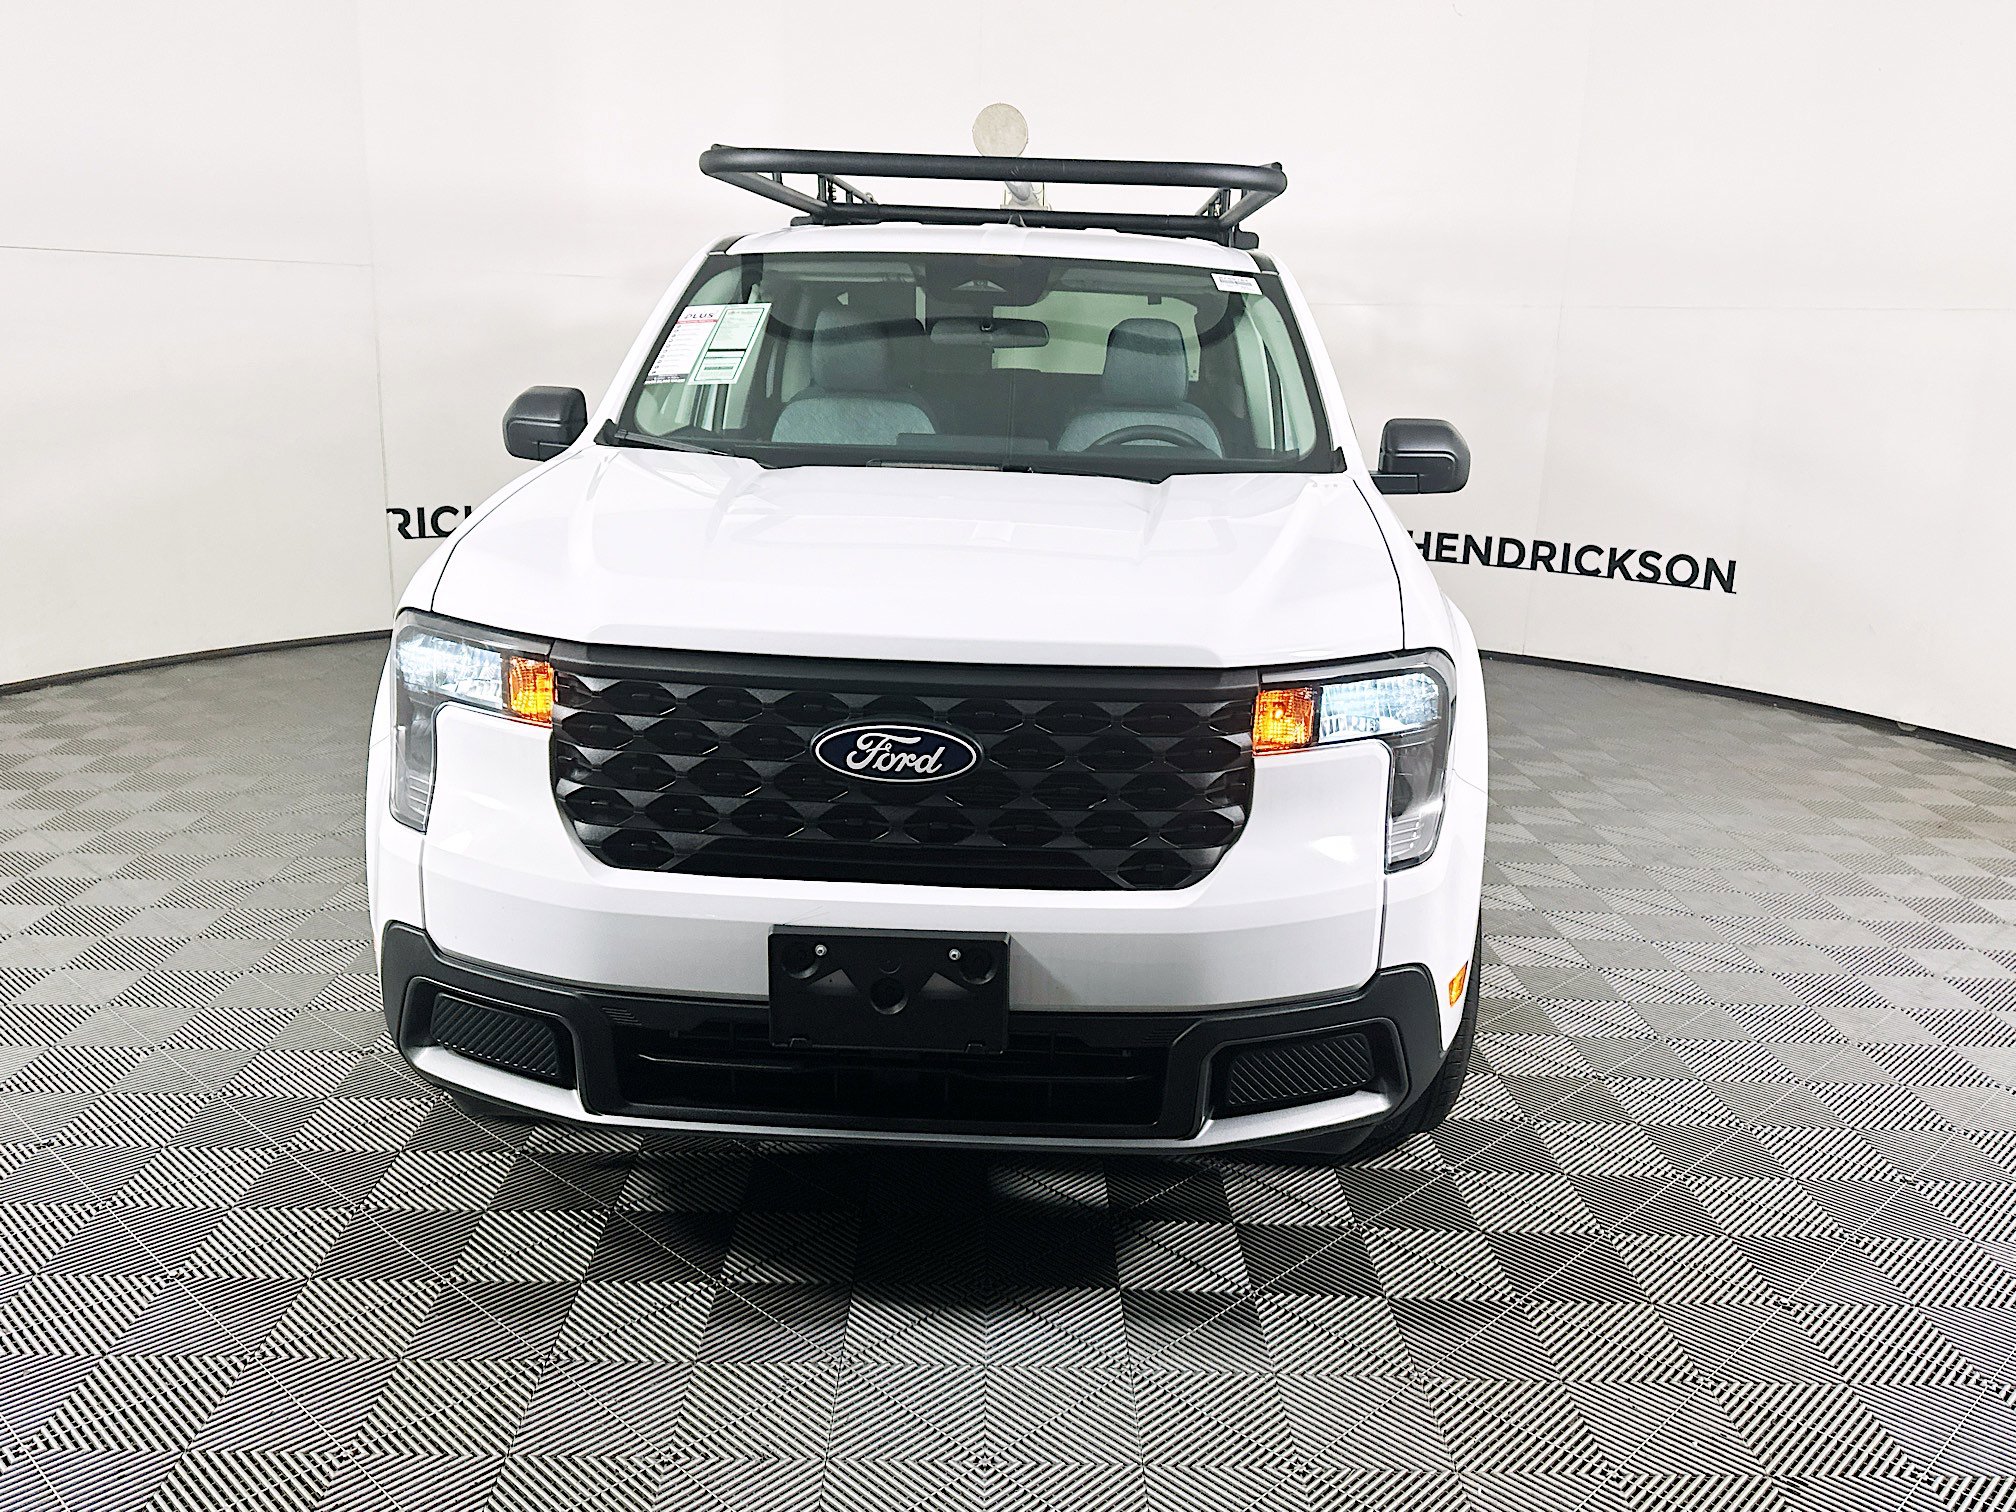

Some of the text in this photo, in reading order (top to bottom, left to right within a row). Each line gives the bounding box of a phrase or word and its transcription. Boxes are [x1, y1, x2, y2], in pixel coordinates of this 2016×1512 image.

[386, 505, 472, 539] RIC
[1407, 530, 1736, 594] HENDRICKSON
[846, 732, 945, 774] Ford
